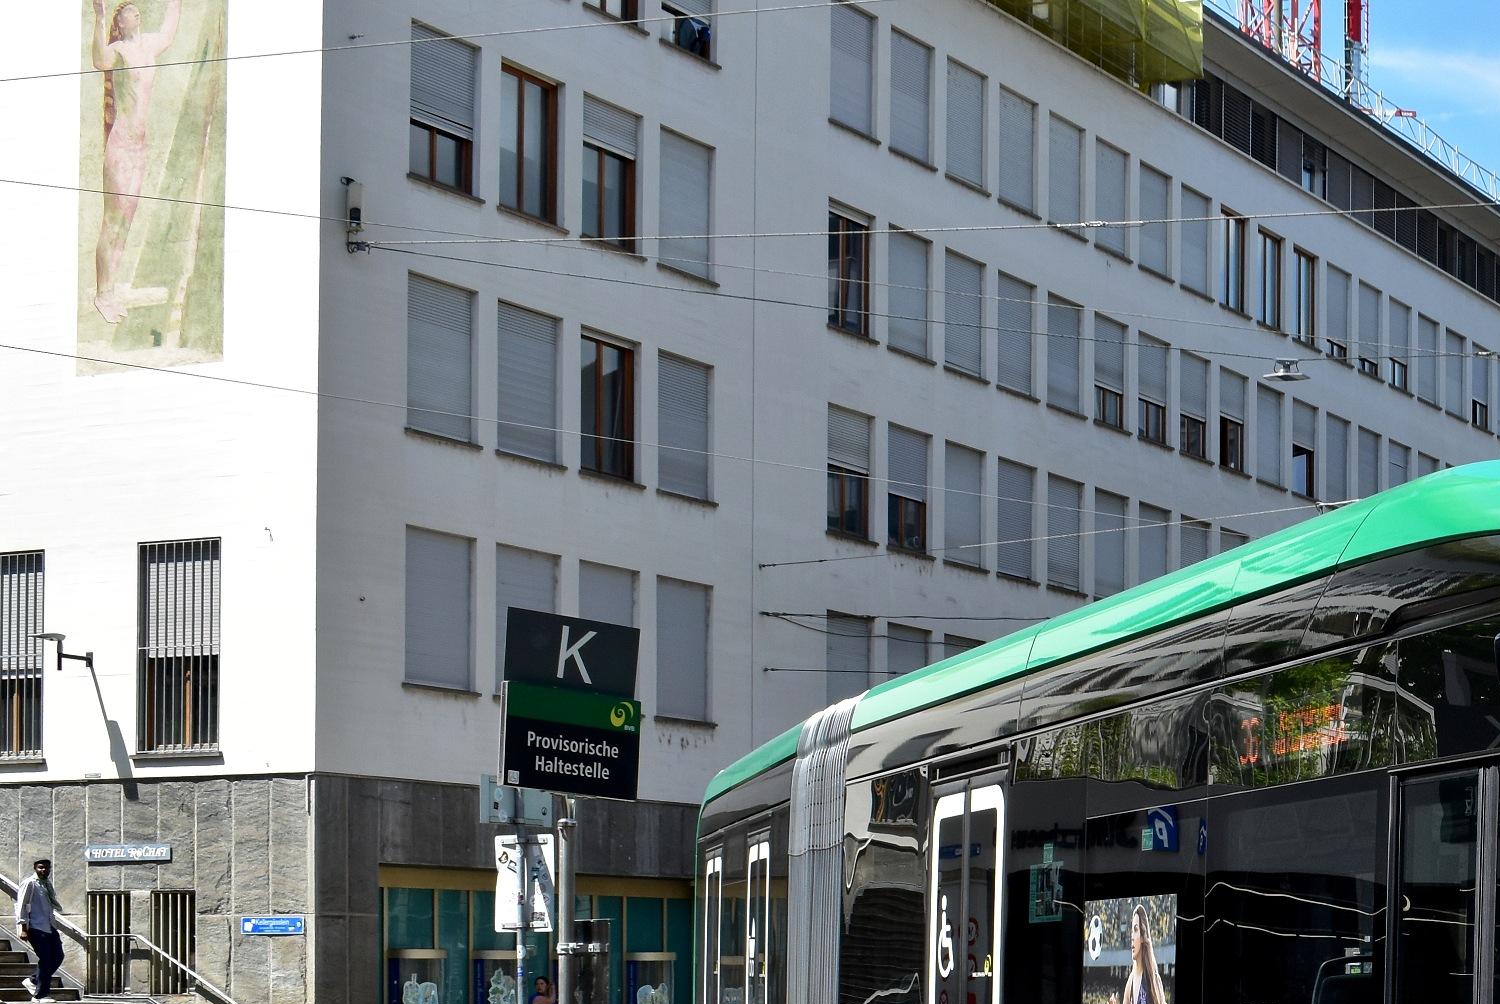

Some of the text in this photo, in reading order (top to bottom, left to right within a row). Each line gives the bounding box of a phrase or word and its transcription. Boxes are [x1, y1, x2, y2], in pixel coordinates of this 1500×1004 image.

[556, 624, 598, 685] K
[527, 730, 619, 759] Provisorische
[535, 755, 610, 780] Haltestelle
[91, 847, 127, 859] HOTEL
